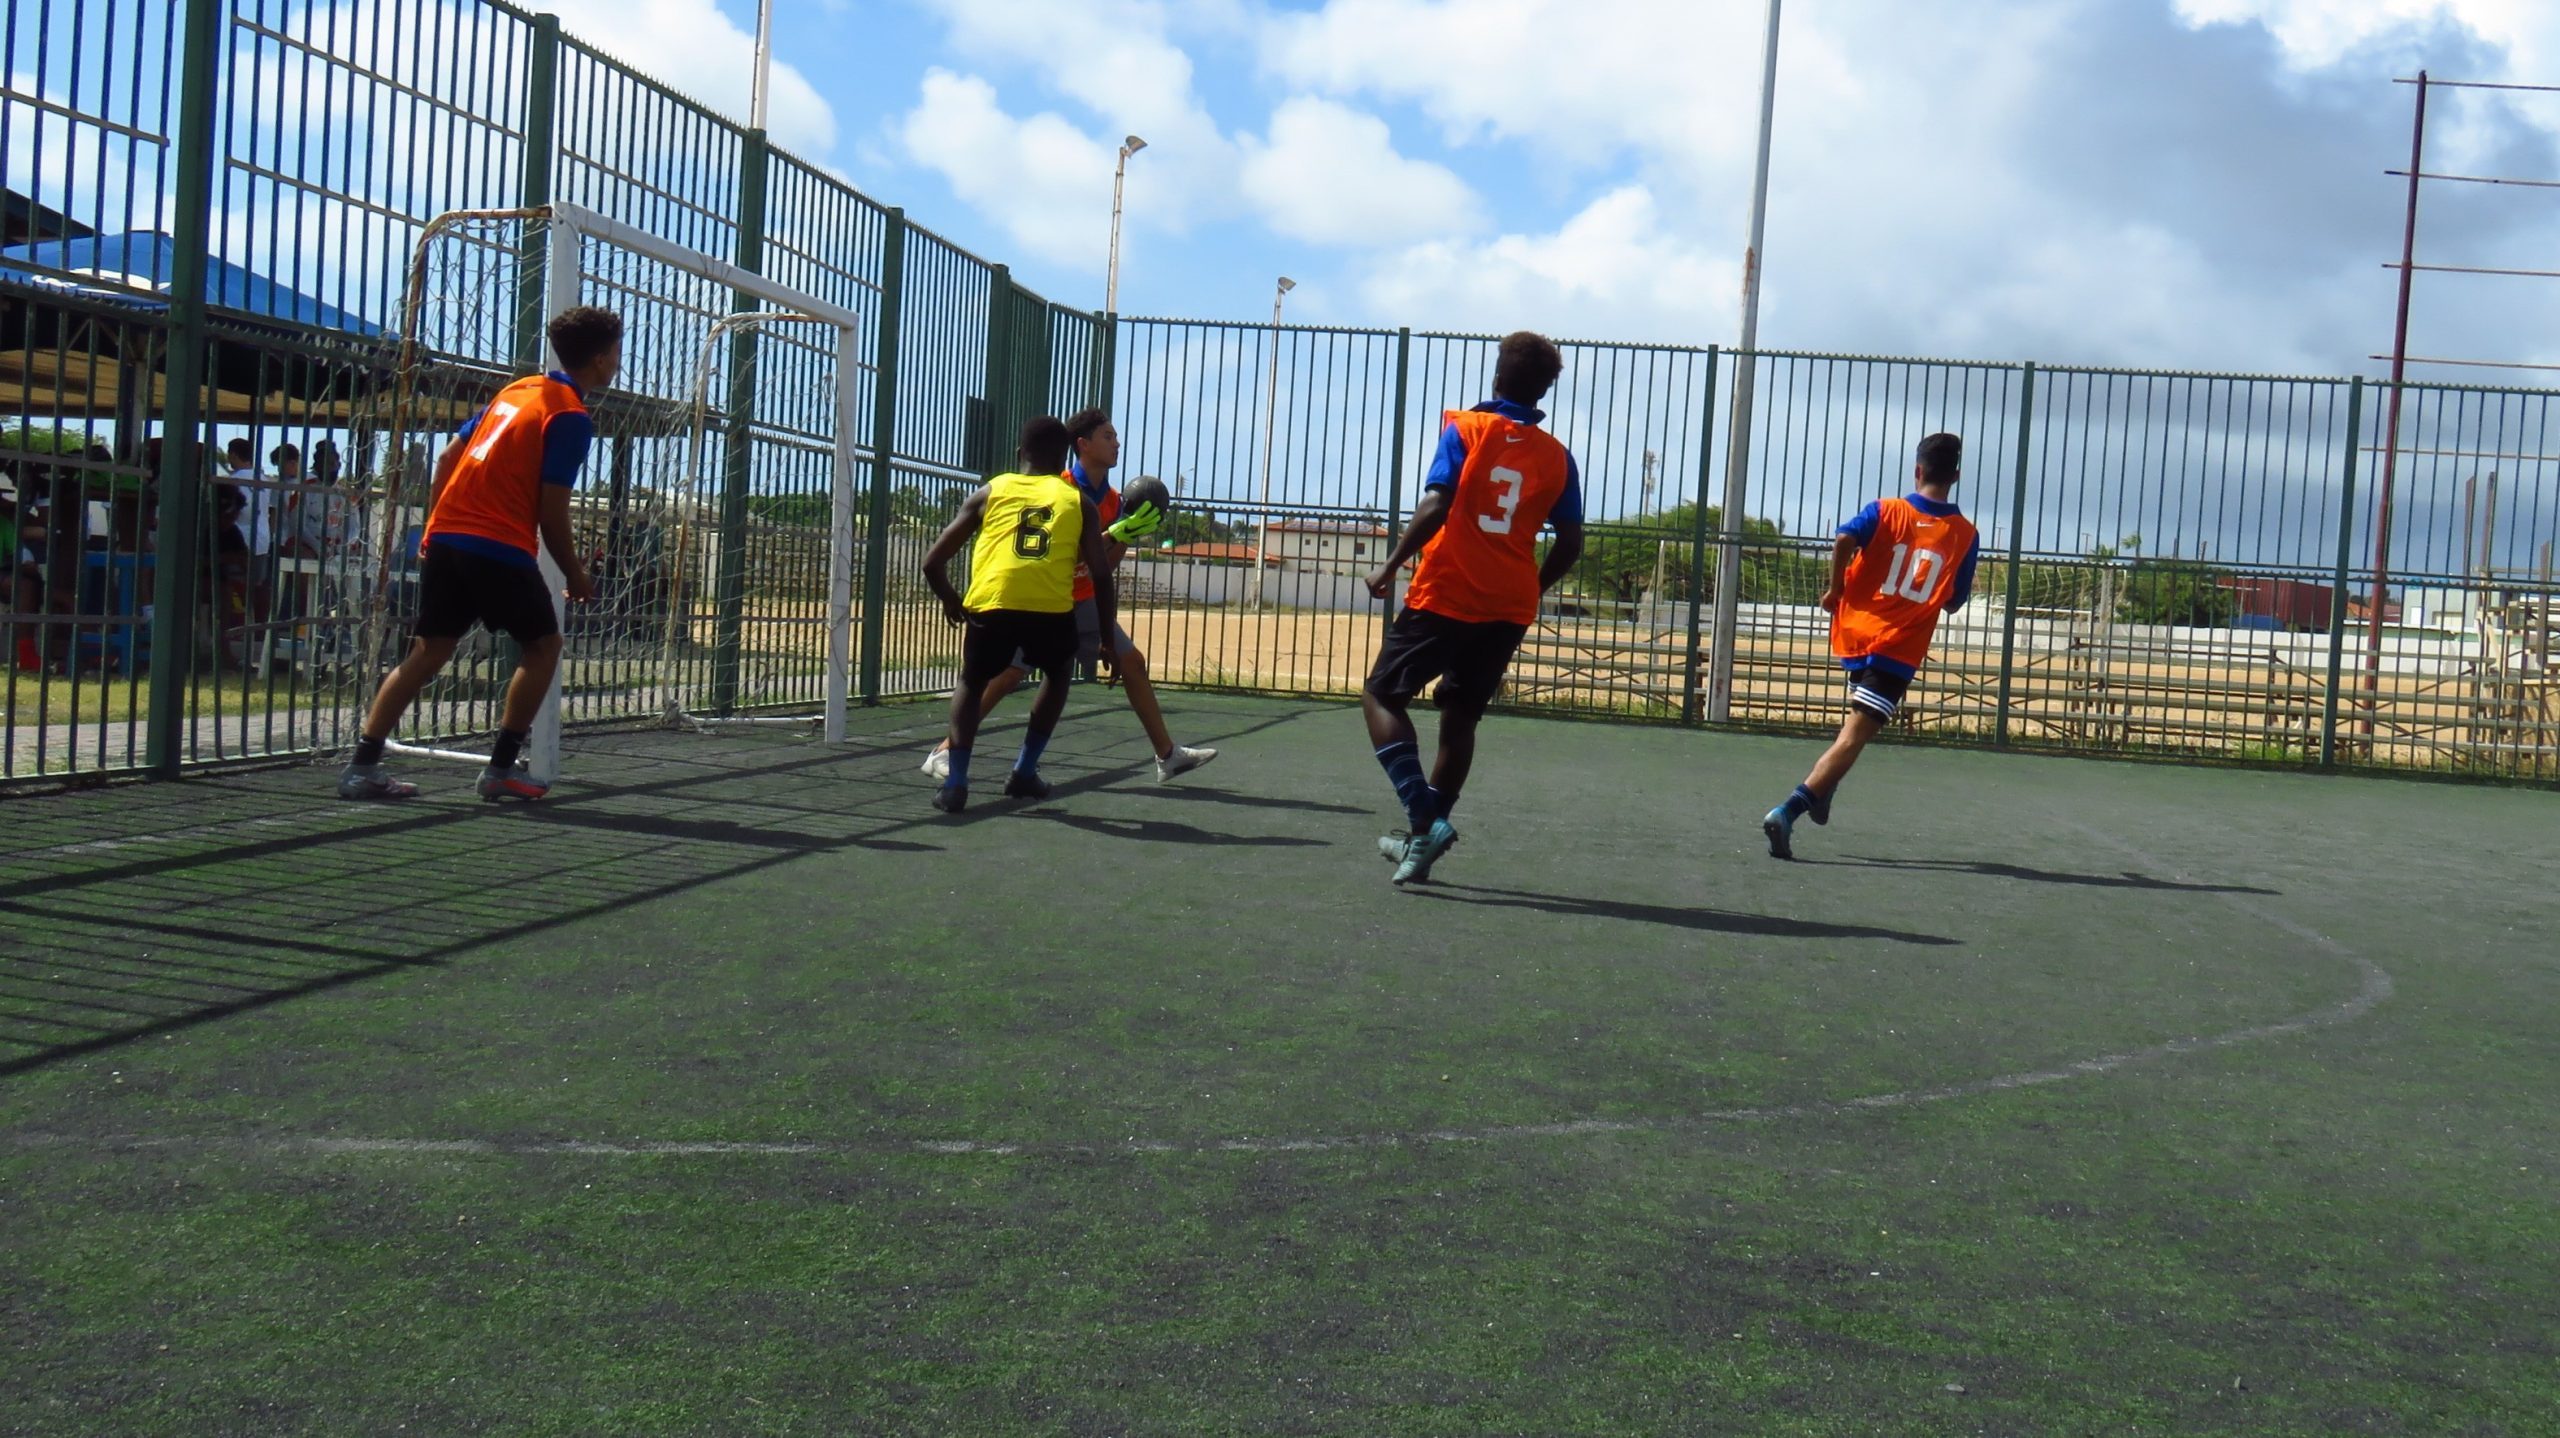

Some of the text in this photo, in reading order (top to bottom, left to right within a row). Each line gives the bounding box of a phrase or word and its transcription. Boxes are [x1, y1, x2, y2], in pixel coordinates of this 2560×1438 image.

[470, 401, 520, 462] 7
[1478, 466, 1523, 535] 3
[1012, 505, 1054, 560] 6
[1879, 543, 1944, 604] 10
